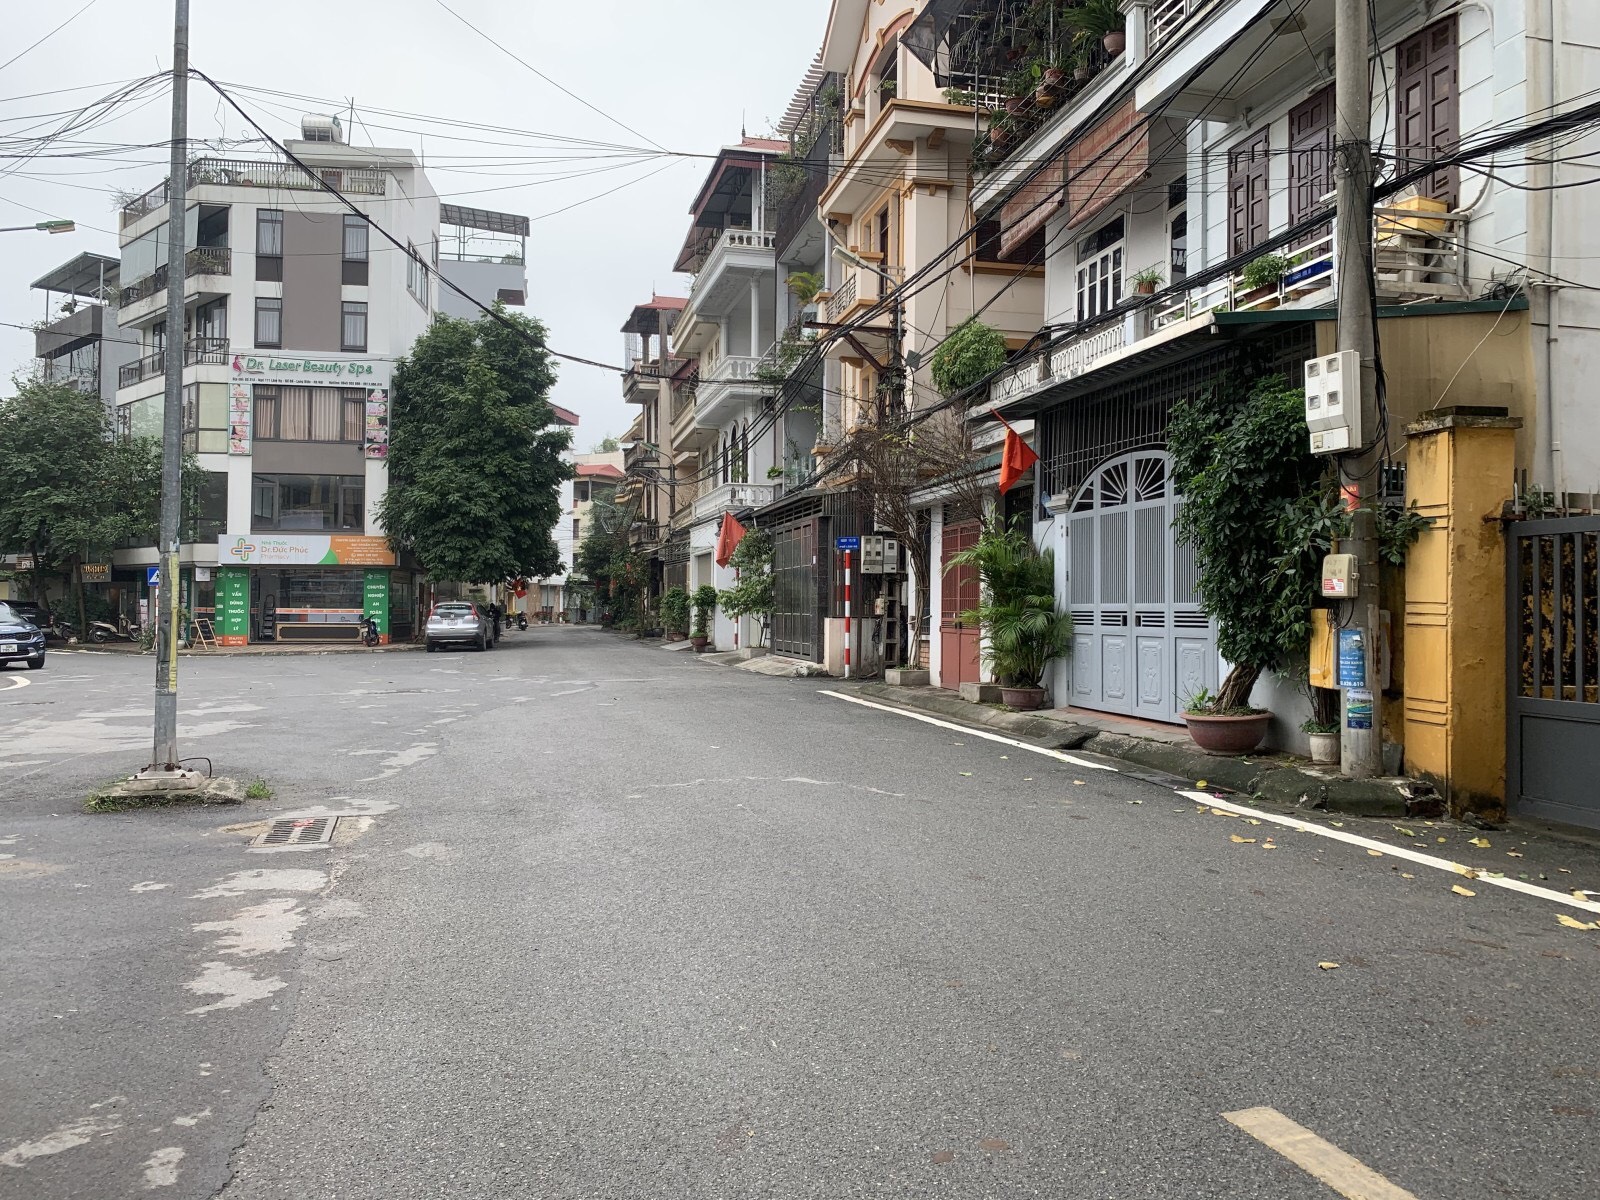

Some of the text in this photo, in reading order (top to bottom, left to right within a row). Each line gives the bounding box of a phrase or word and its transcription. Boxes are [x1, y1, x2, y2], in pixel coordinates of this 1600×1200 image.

[246, 357, 373, 378] Dr. Laser Beauty Spa
[289, 546, 309, 554] Phúc
